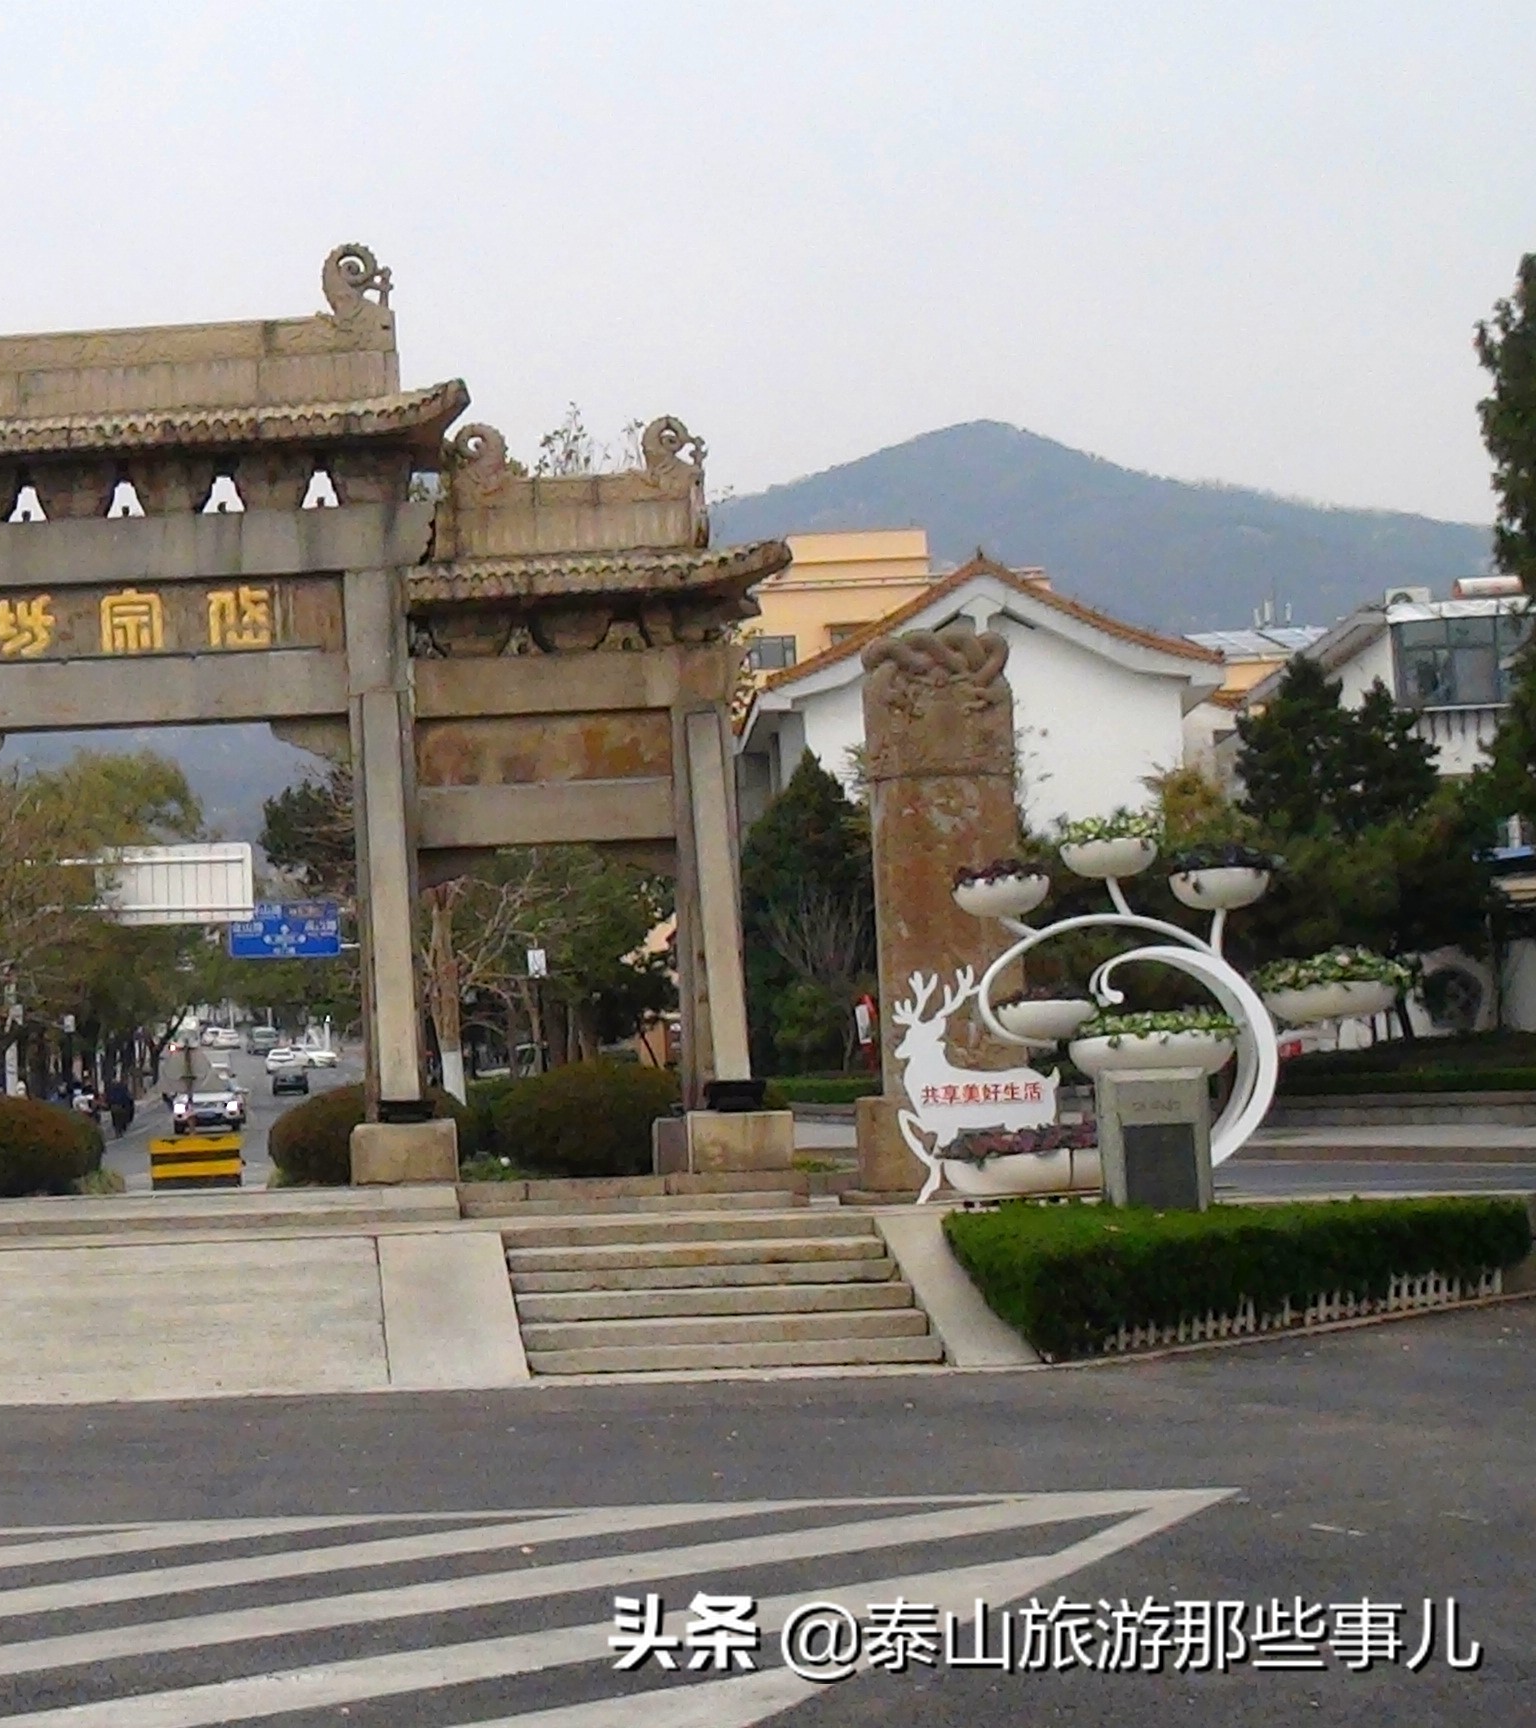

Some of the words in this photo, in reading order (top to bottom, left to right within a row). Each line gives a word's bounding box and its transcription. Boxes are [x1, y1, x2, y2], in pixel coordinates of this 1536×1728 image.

[920, 1081, 1043, 1105] 共享美好生活
